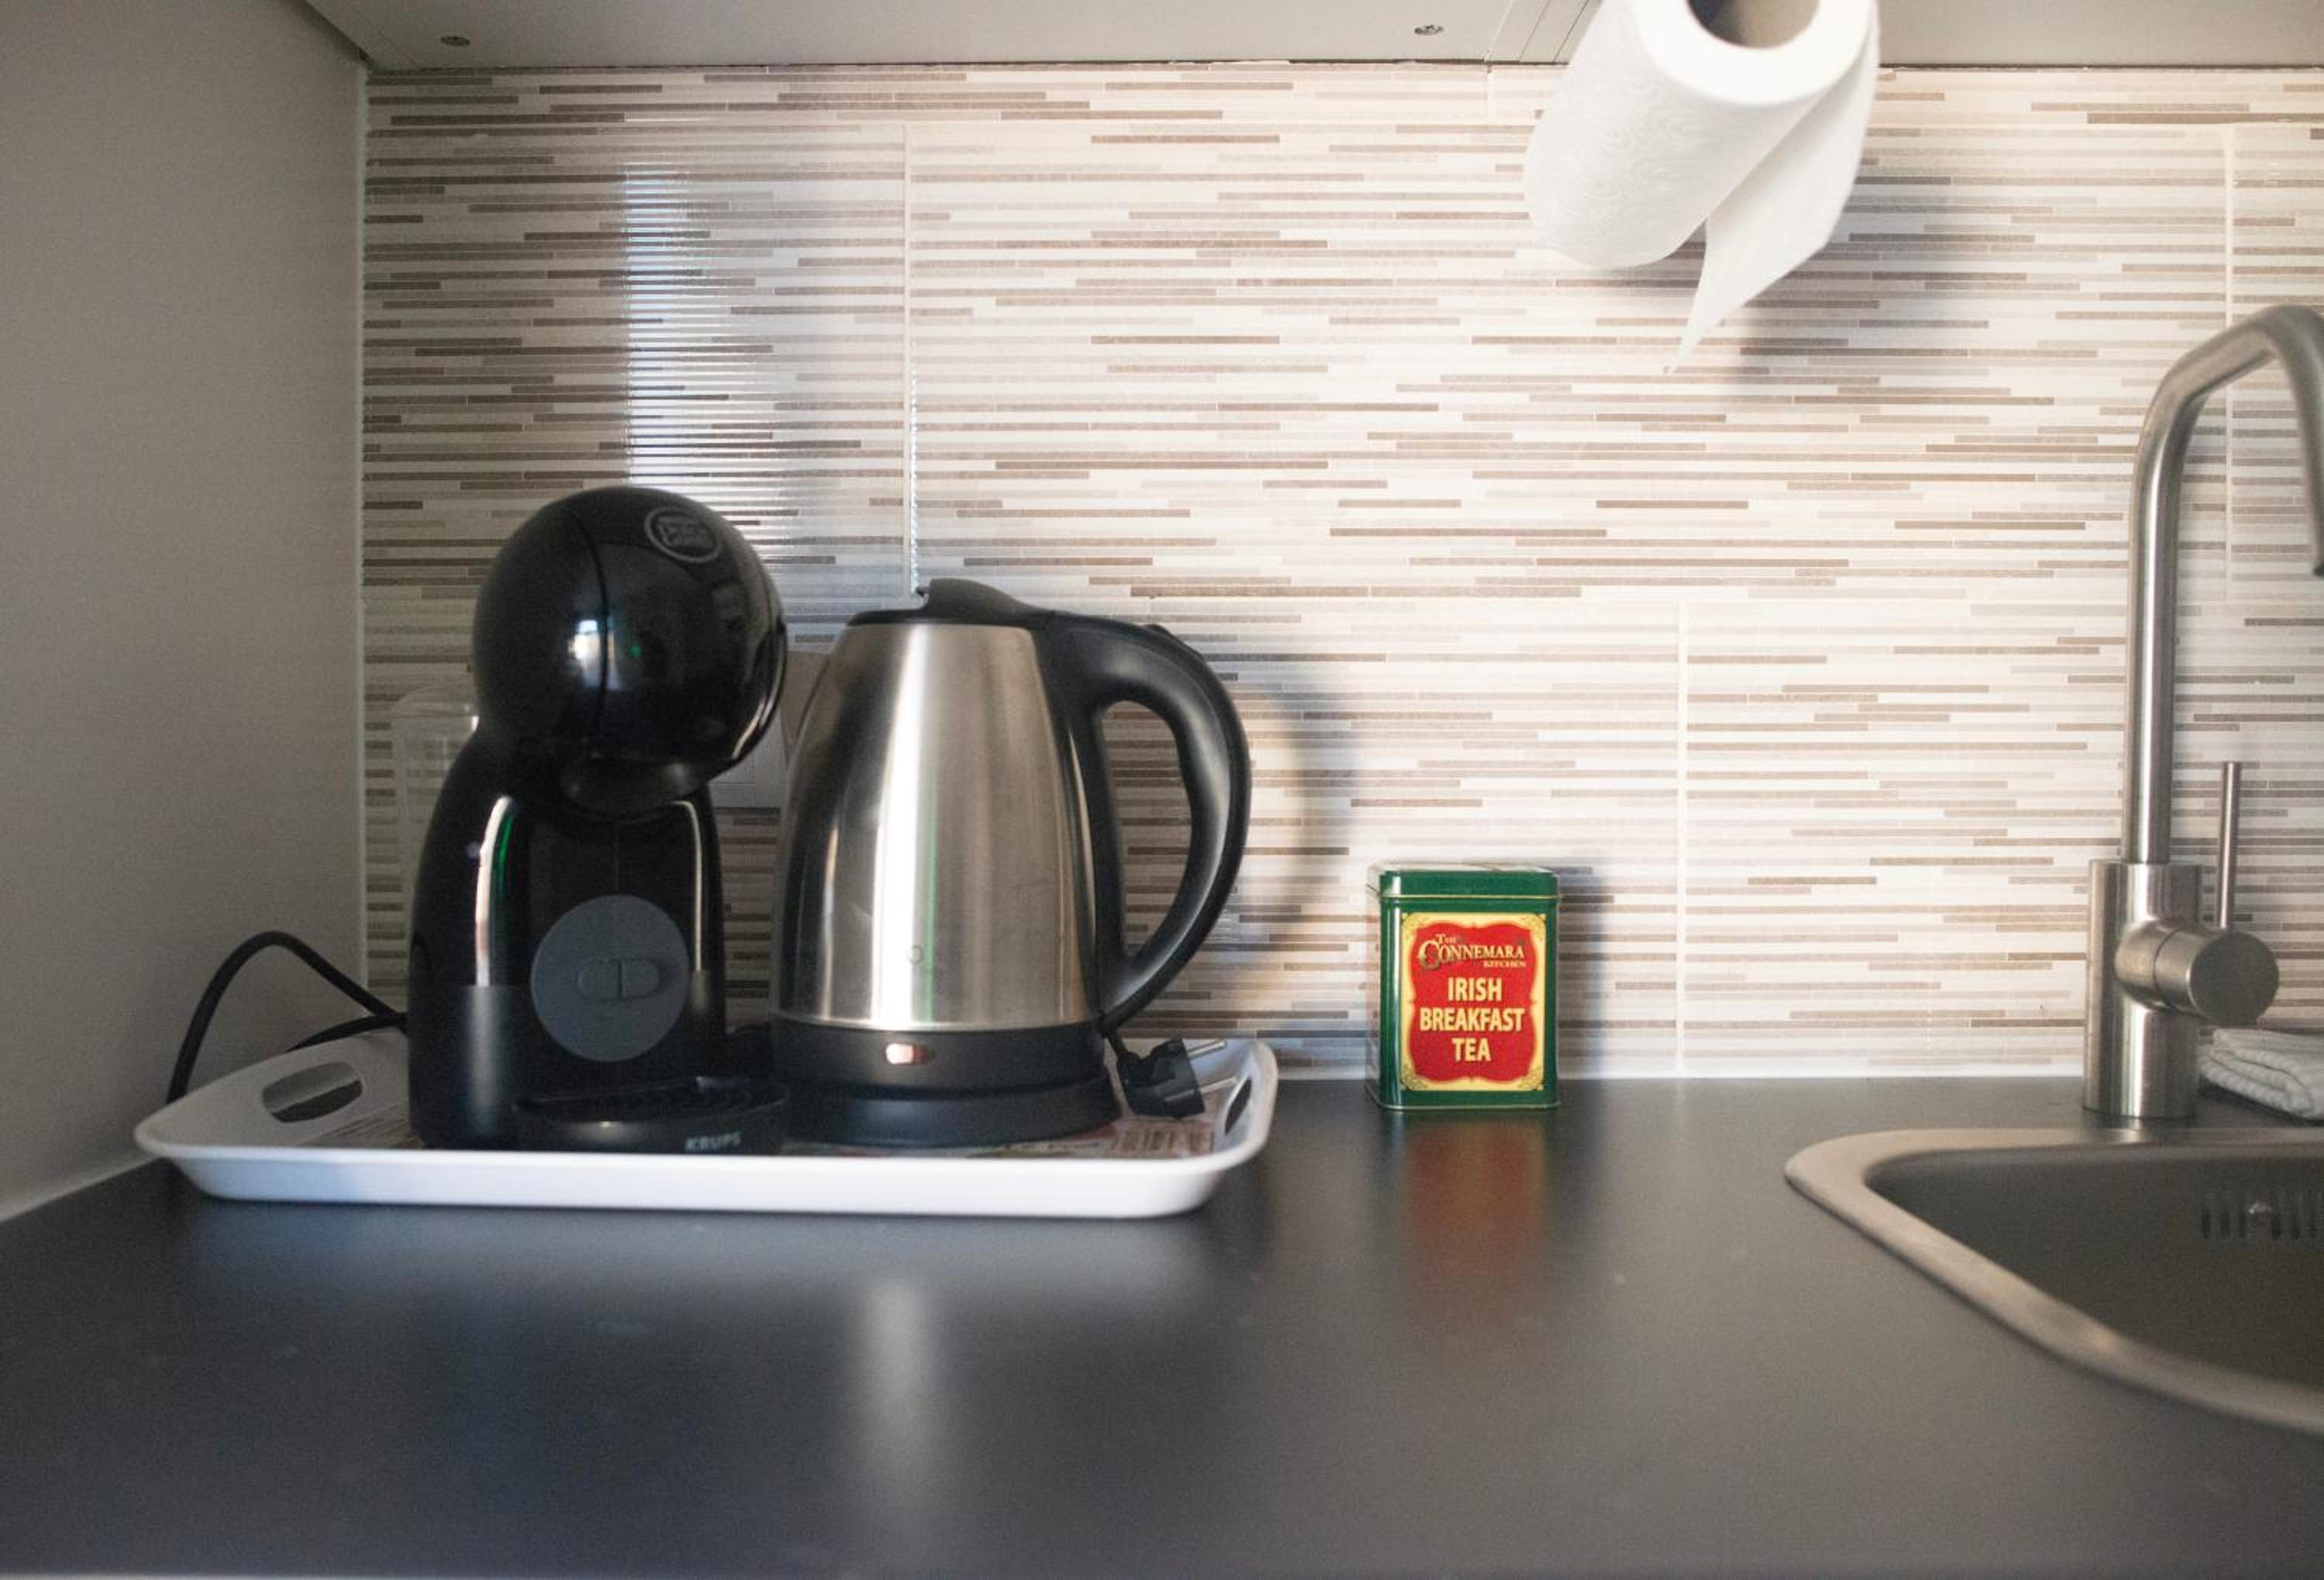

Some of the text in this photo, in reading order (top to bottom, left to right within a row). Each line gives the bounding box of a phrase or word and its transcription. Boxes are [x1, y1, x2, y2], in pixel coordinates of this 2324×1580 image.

[1447, 977, 1503, 1001] IRISH
[1419, 1008, 1525, 1032] BREAKFAST
[1452, 1038, 1491, 1062] TEA
